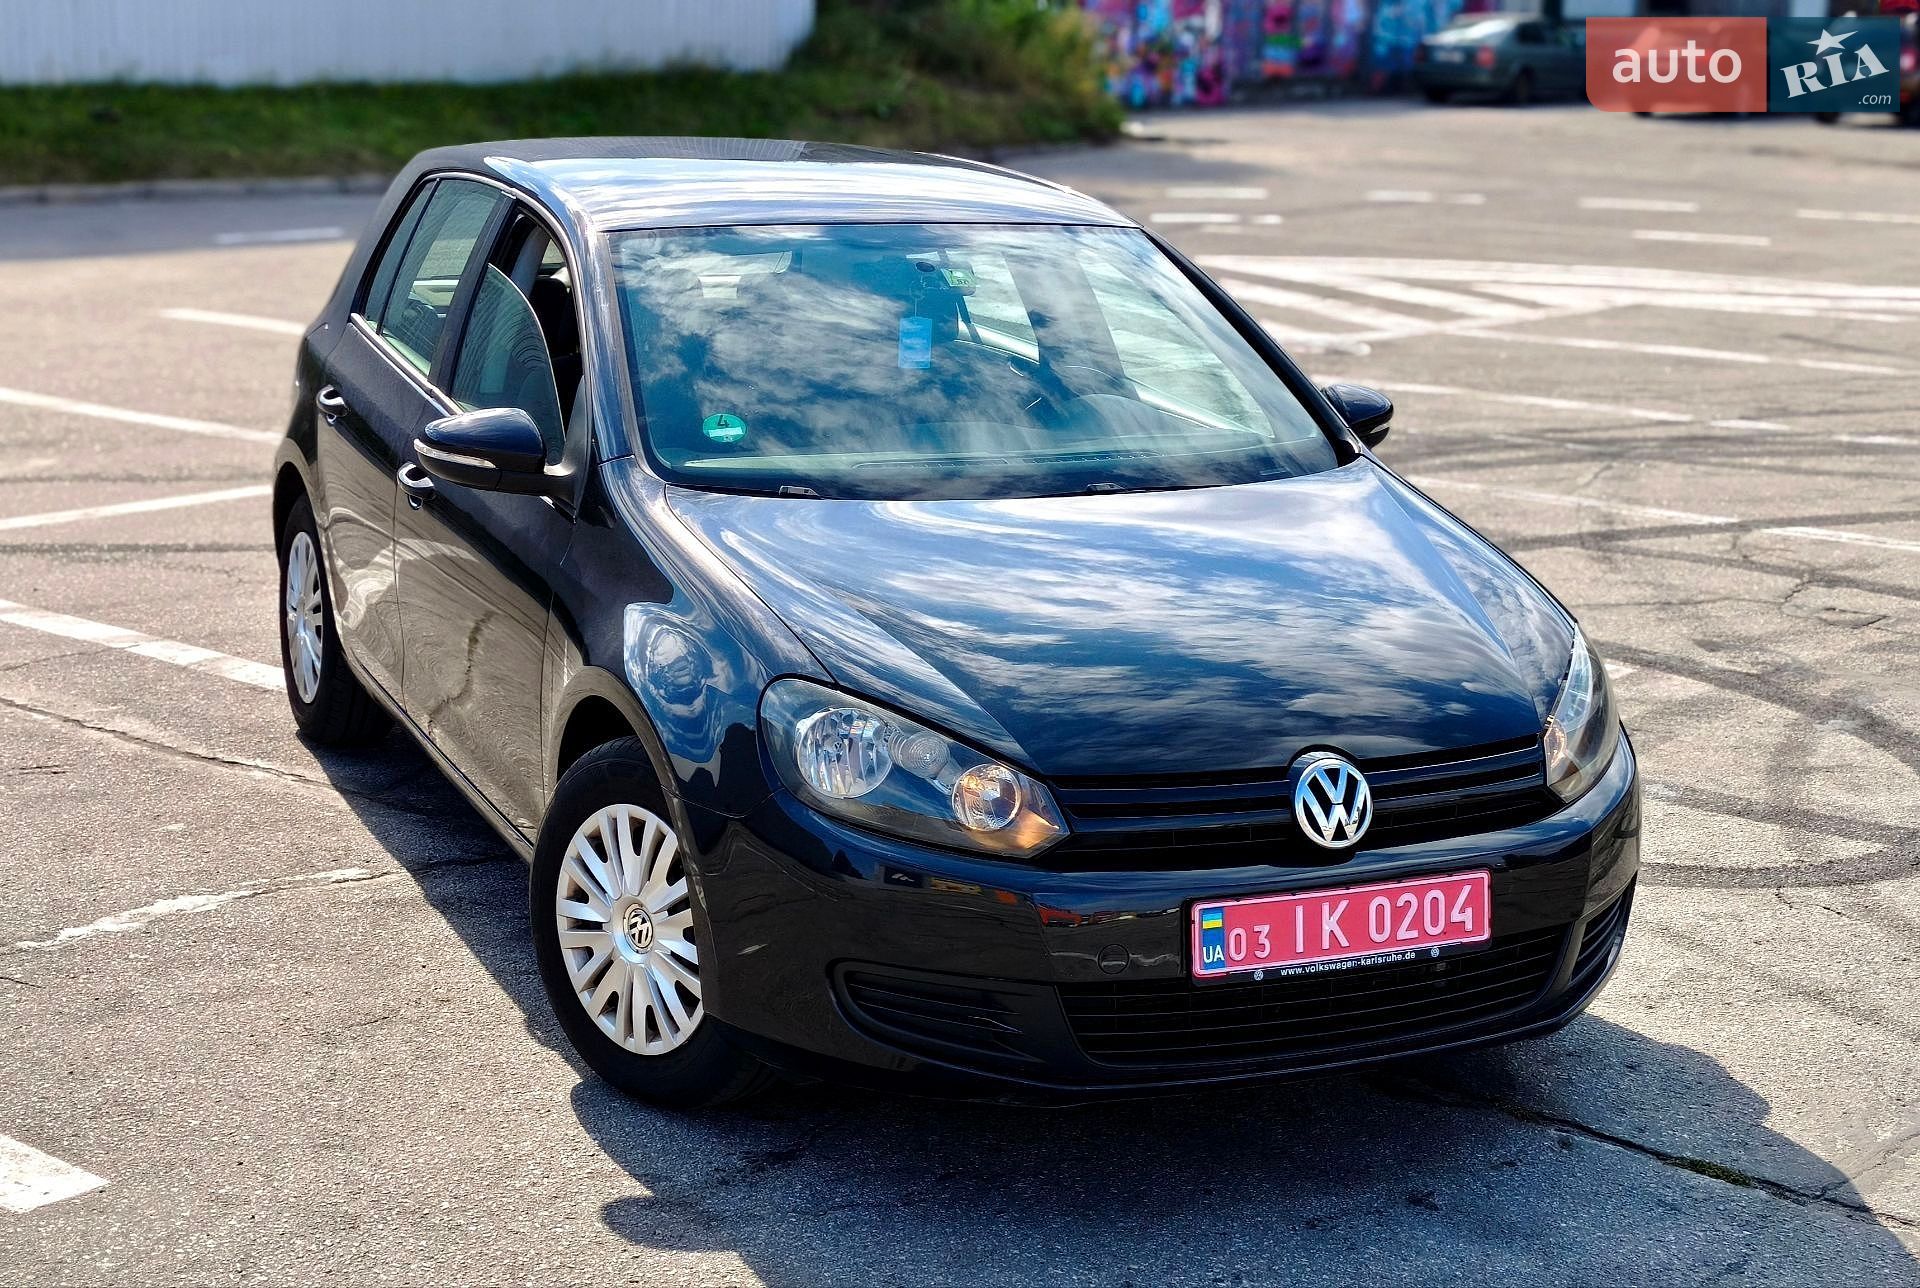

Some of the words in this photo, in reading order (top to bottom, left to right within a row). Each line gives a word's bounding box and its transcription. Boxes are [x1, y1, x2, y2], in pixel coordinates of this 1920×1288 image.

[1228, 924, 1271, 962] 03
[1368, 884, 1474, 944] 0204
[1202, 945, 1226, 964] UA
